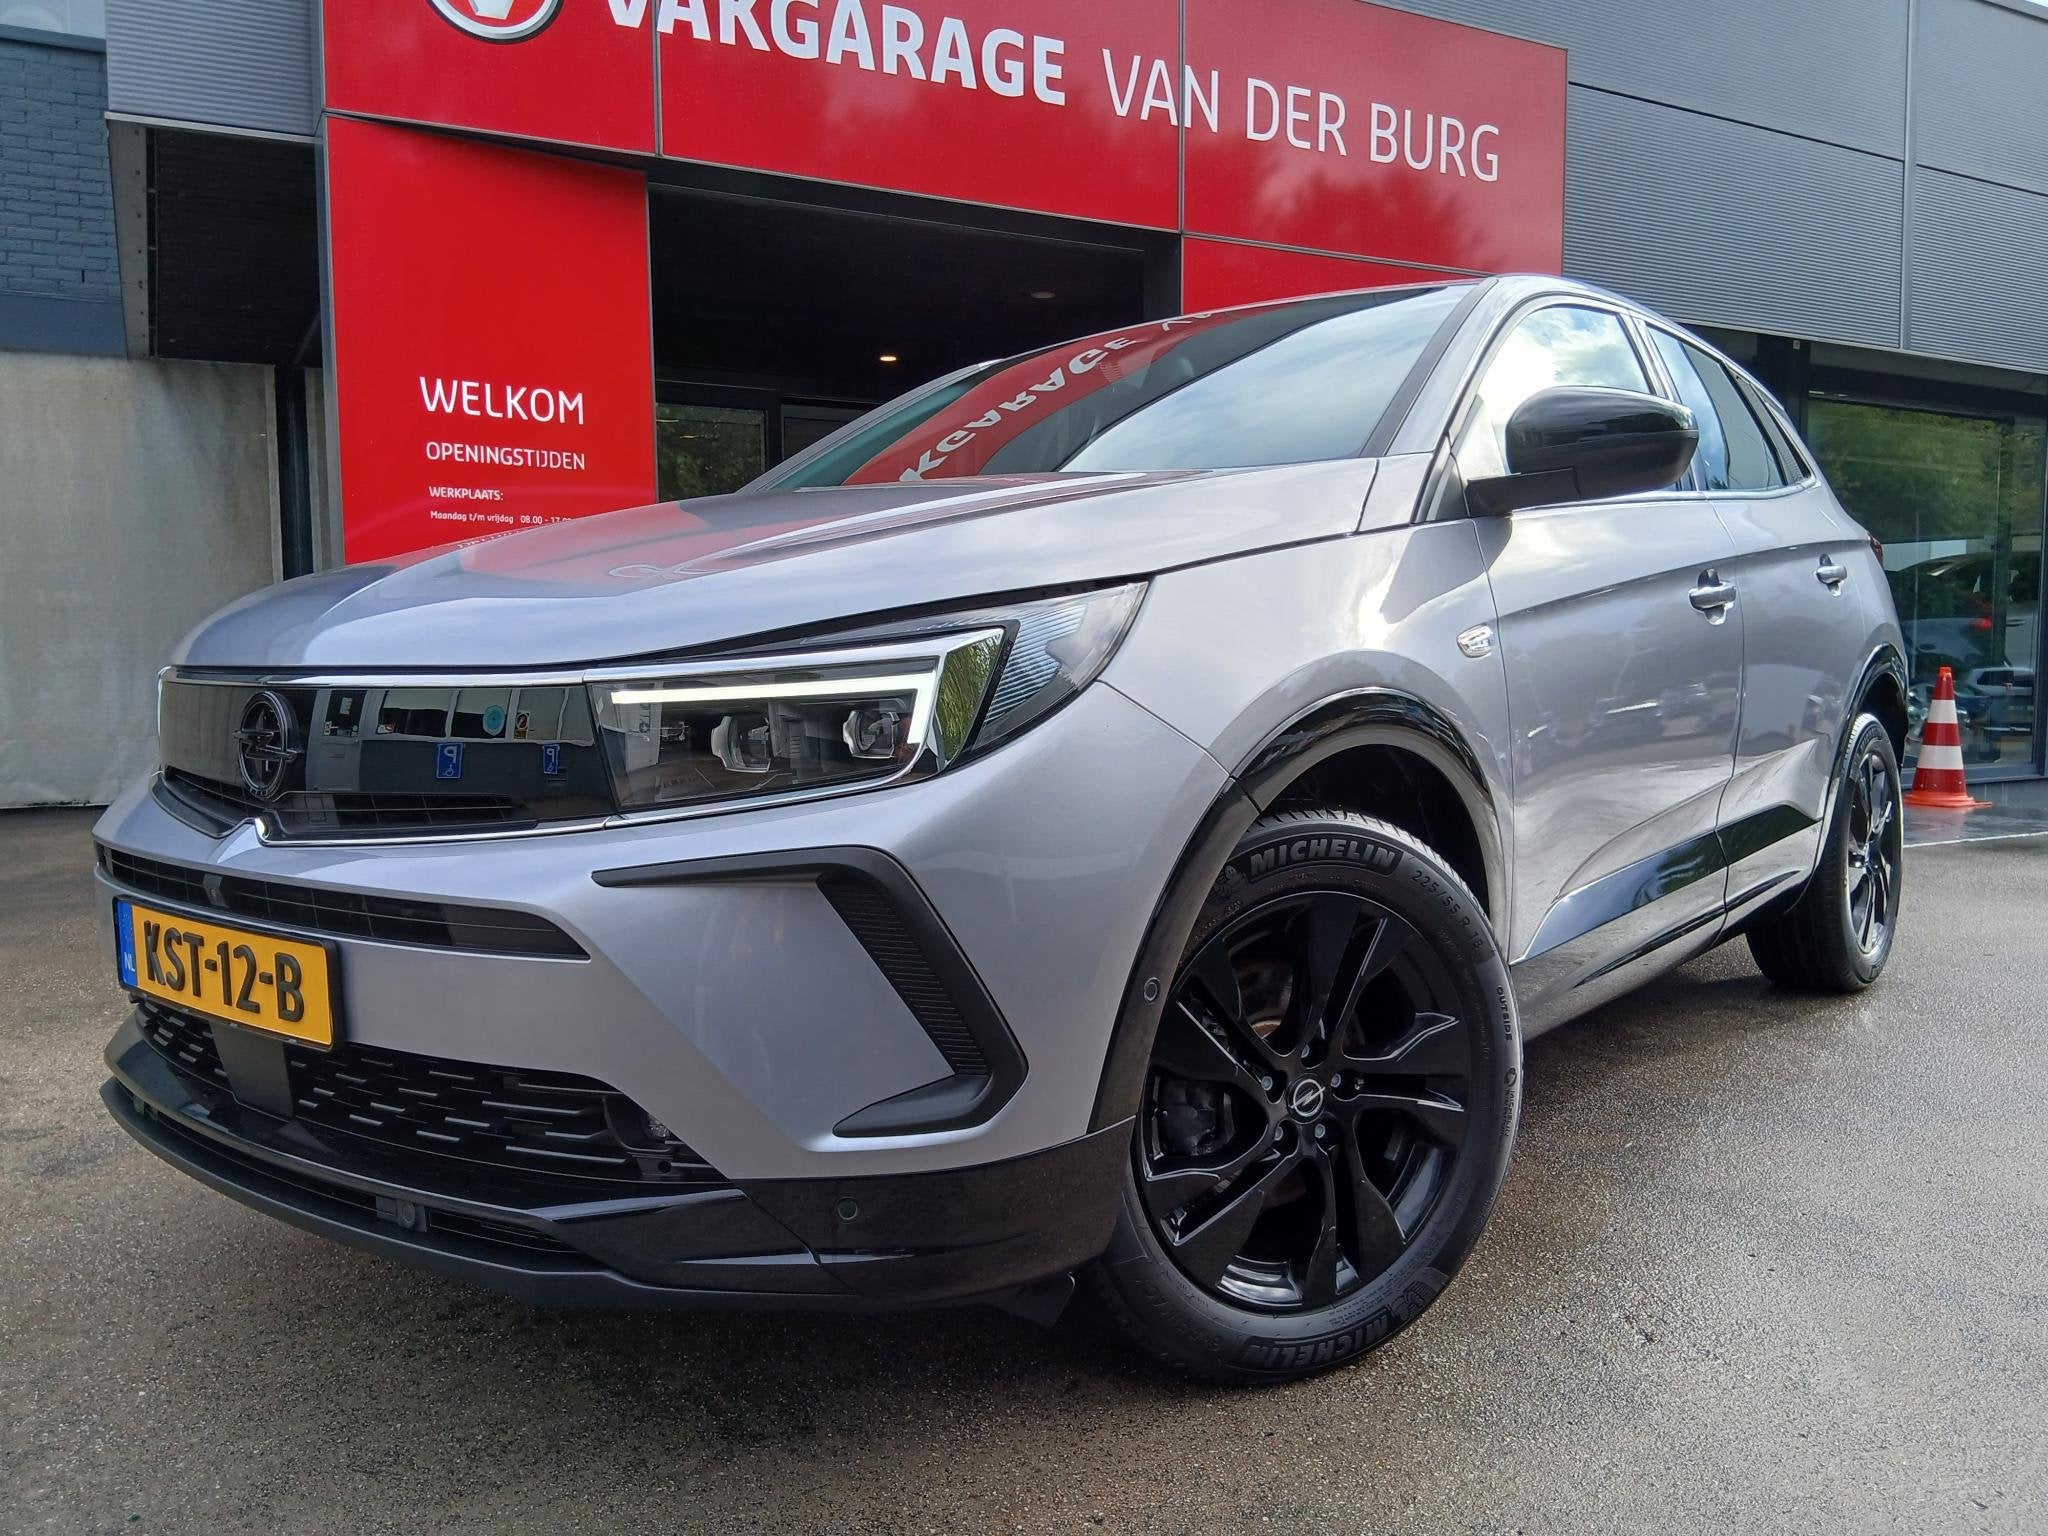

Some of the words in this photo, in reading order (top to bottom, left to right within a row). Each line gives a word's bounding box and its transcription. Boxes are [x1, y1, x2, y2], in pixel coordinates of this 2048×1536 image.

[1102, 48, 1219, 133] VAN
[1246, 77, 1348, 156] DER
[1369, 103, 1499, 182] BURG
[419, 376, 584, 425] WELKOM
[426, 441, 586, 470] OPENINGSTIJDEN
[428, 486, 504, 501] WERKPLAATS:
[430, 510, 467, 522] Maandag
[469, 512, 485, 522] t/m
[487, 513, 514, 525] vrijdag
[520, 515, 543, 525] 08.00
[1250, 838, 1397, 877] MICHELIN
[1410, 869, 1462, 914] 225/55
[123, 951, 136, 973] NL
[143, 920, 305, 1022] KST-12-B
[1496, 985, 1513, 1042] OUTSIDE
